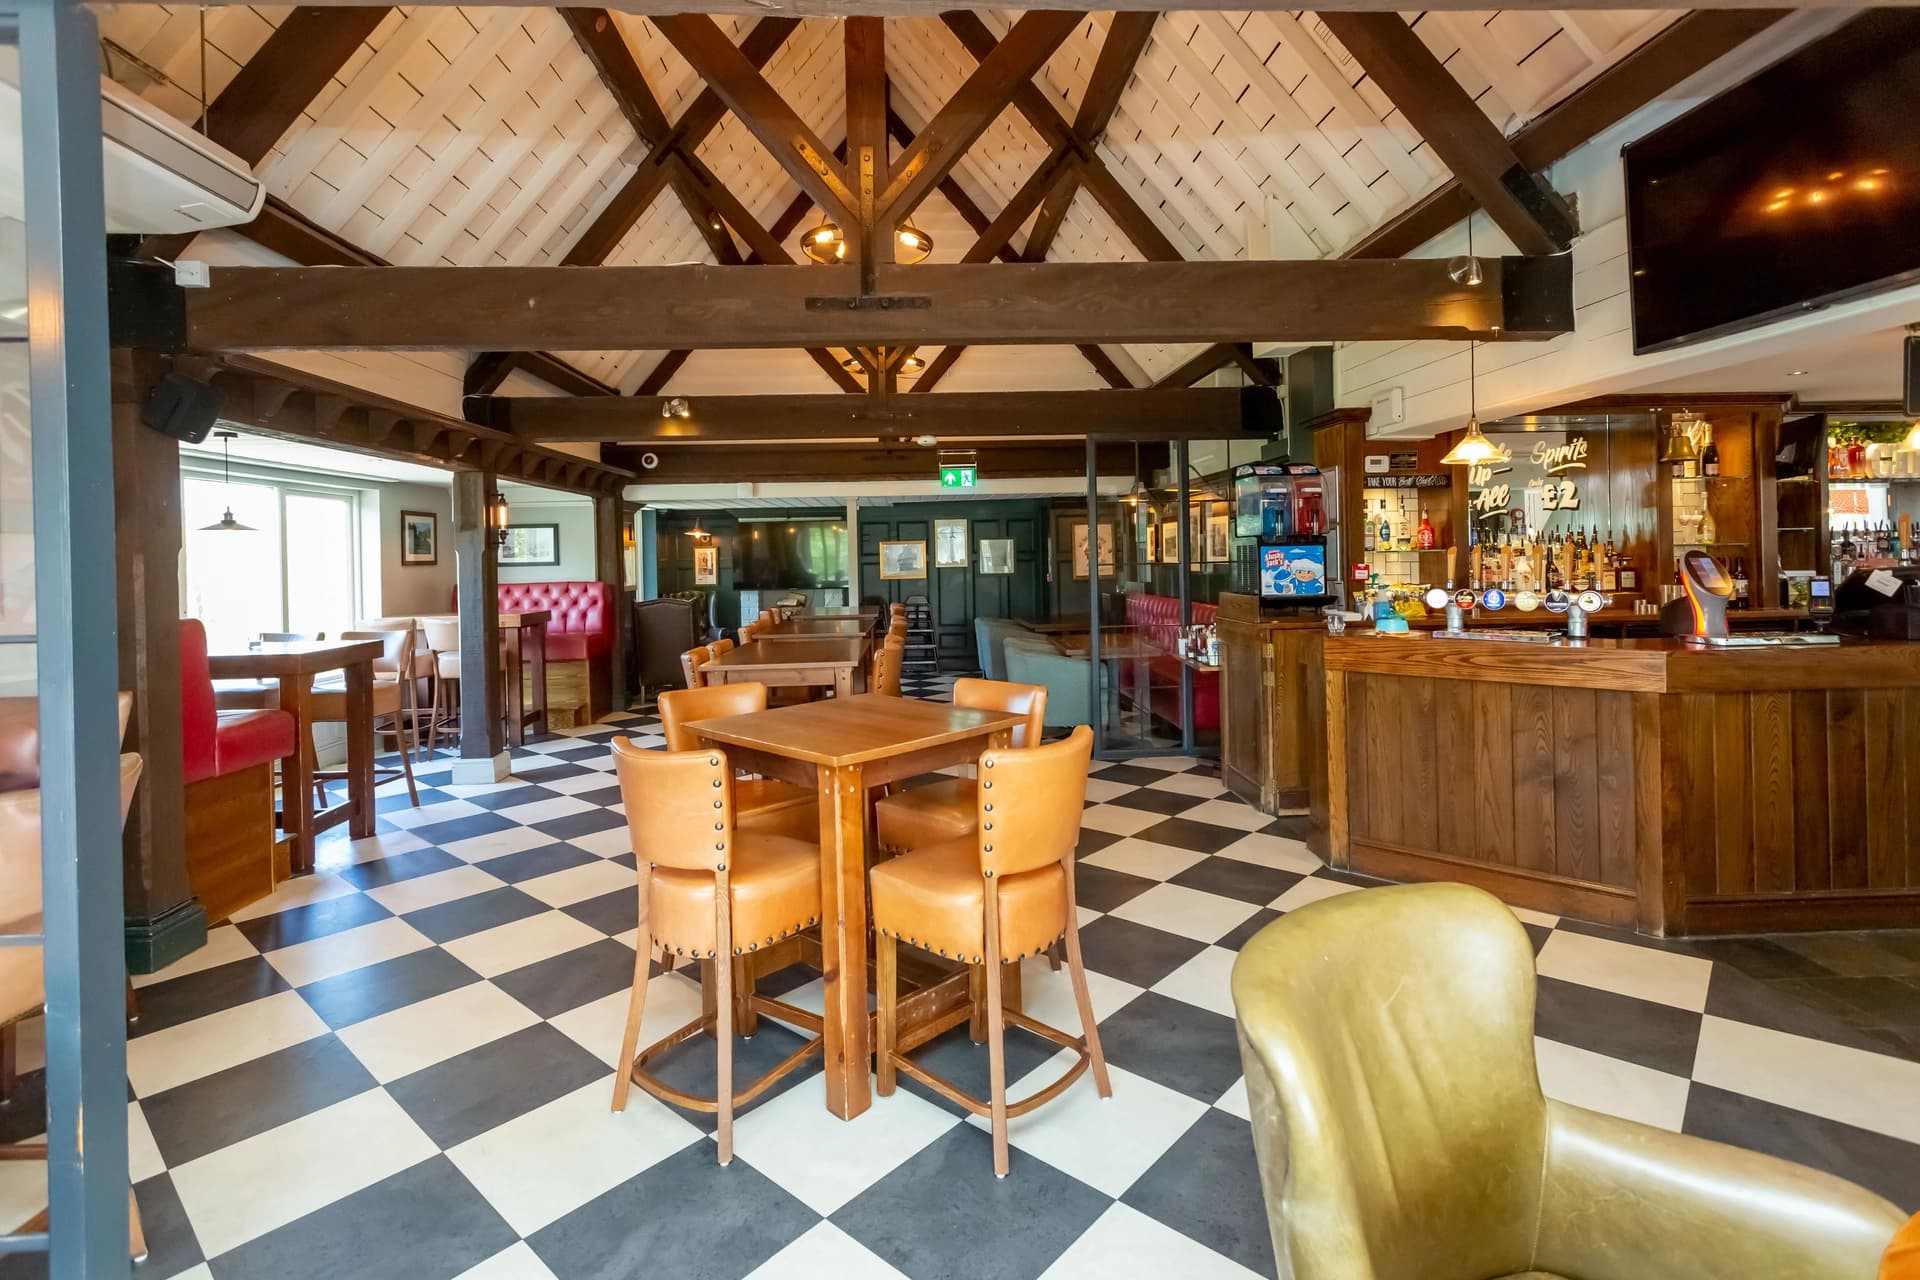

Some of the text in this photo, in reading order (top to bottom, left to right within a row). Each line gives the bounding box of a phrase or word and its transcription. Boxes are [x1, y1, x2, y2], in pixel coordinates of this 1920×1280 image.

[1530, 437, 1588, 470] Spirits
[1474, 484, 1510, 512] All
[1542, 480, 1580, 511] £2
